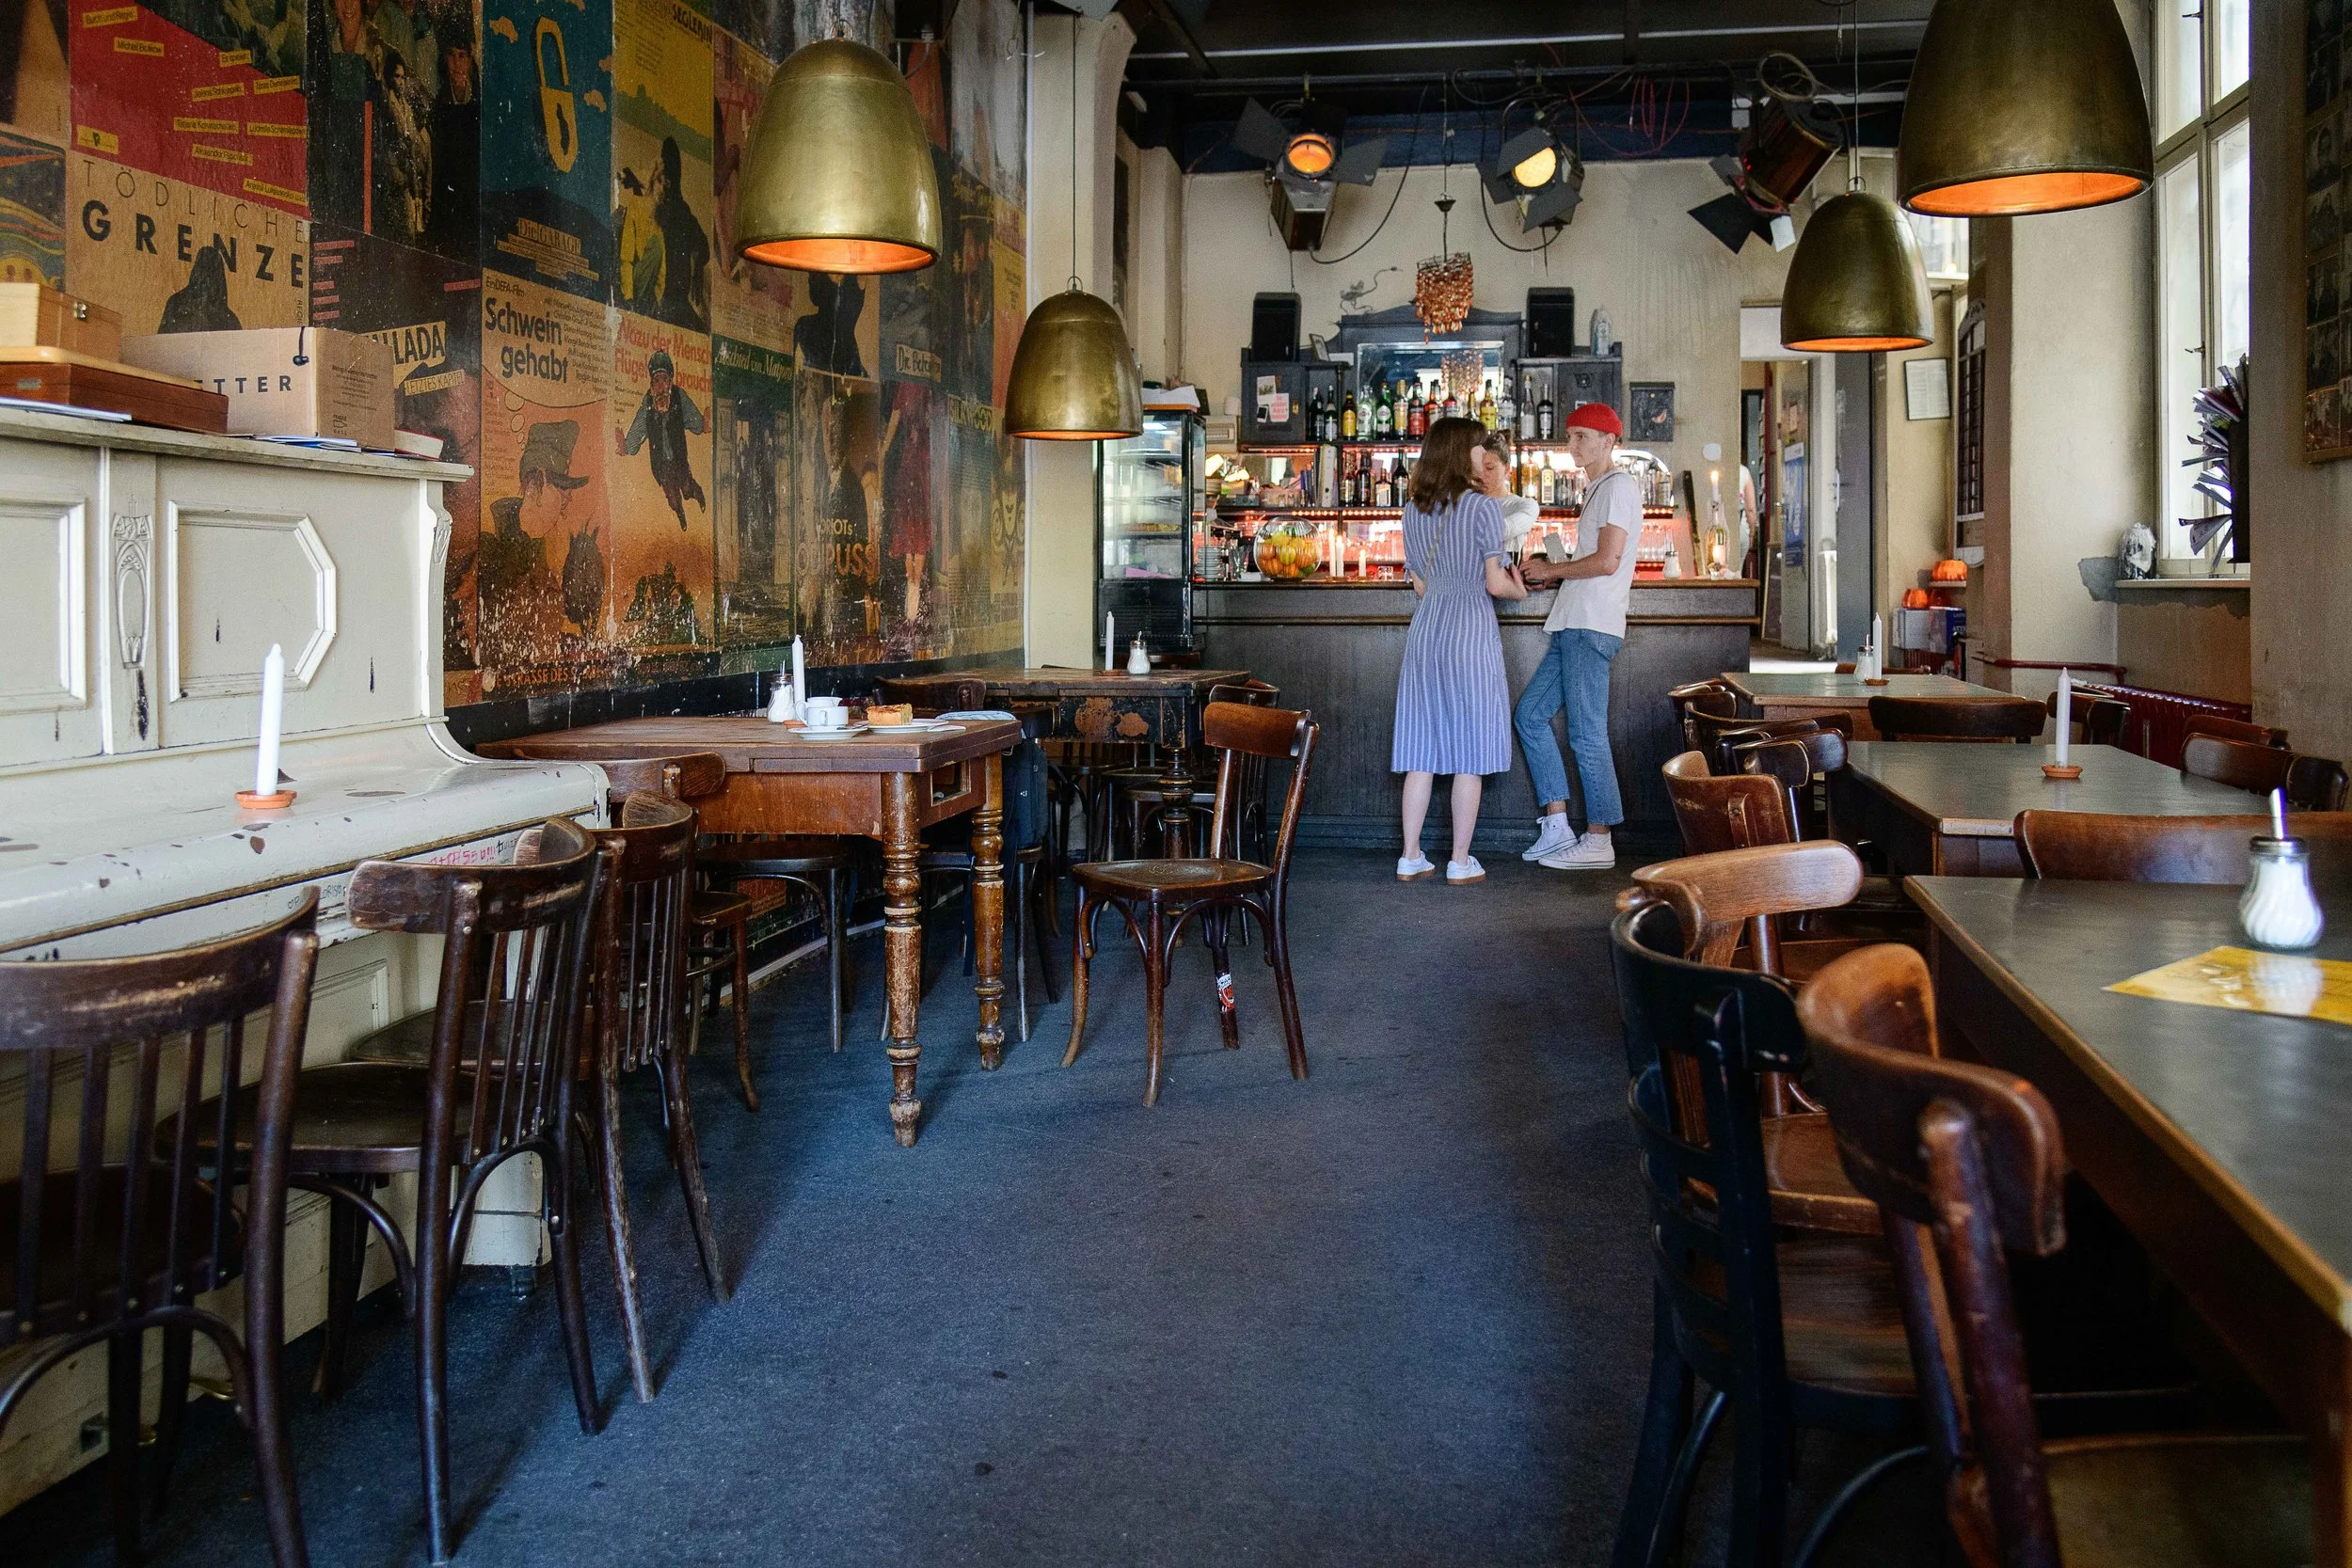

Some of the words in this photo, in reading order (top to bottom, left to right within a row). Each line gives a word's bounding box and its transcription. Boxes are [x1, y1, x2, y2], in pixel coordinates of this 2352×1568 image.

[673, 3, 713, 45] SEGLERIN
[83, 159, 304, 245] TÖDLICHE
[82, 199, 304, 289] GRENZE
[518, 219, 537, 237] Die
[538, 224, 581, 256] GARAGE
[485, 296, 563, 346] Schwein
[501, 342, 569, 384] gehabt
[614, 347, 648, 384] Flügel
[195, 374, 292, 397] TTER
[551, 666, 569, 683] DES
